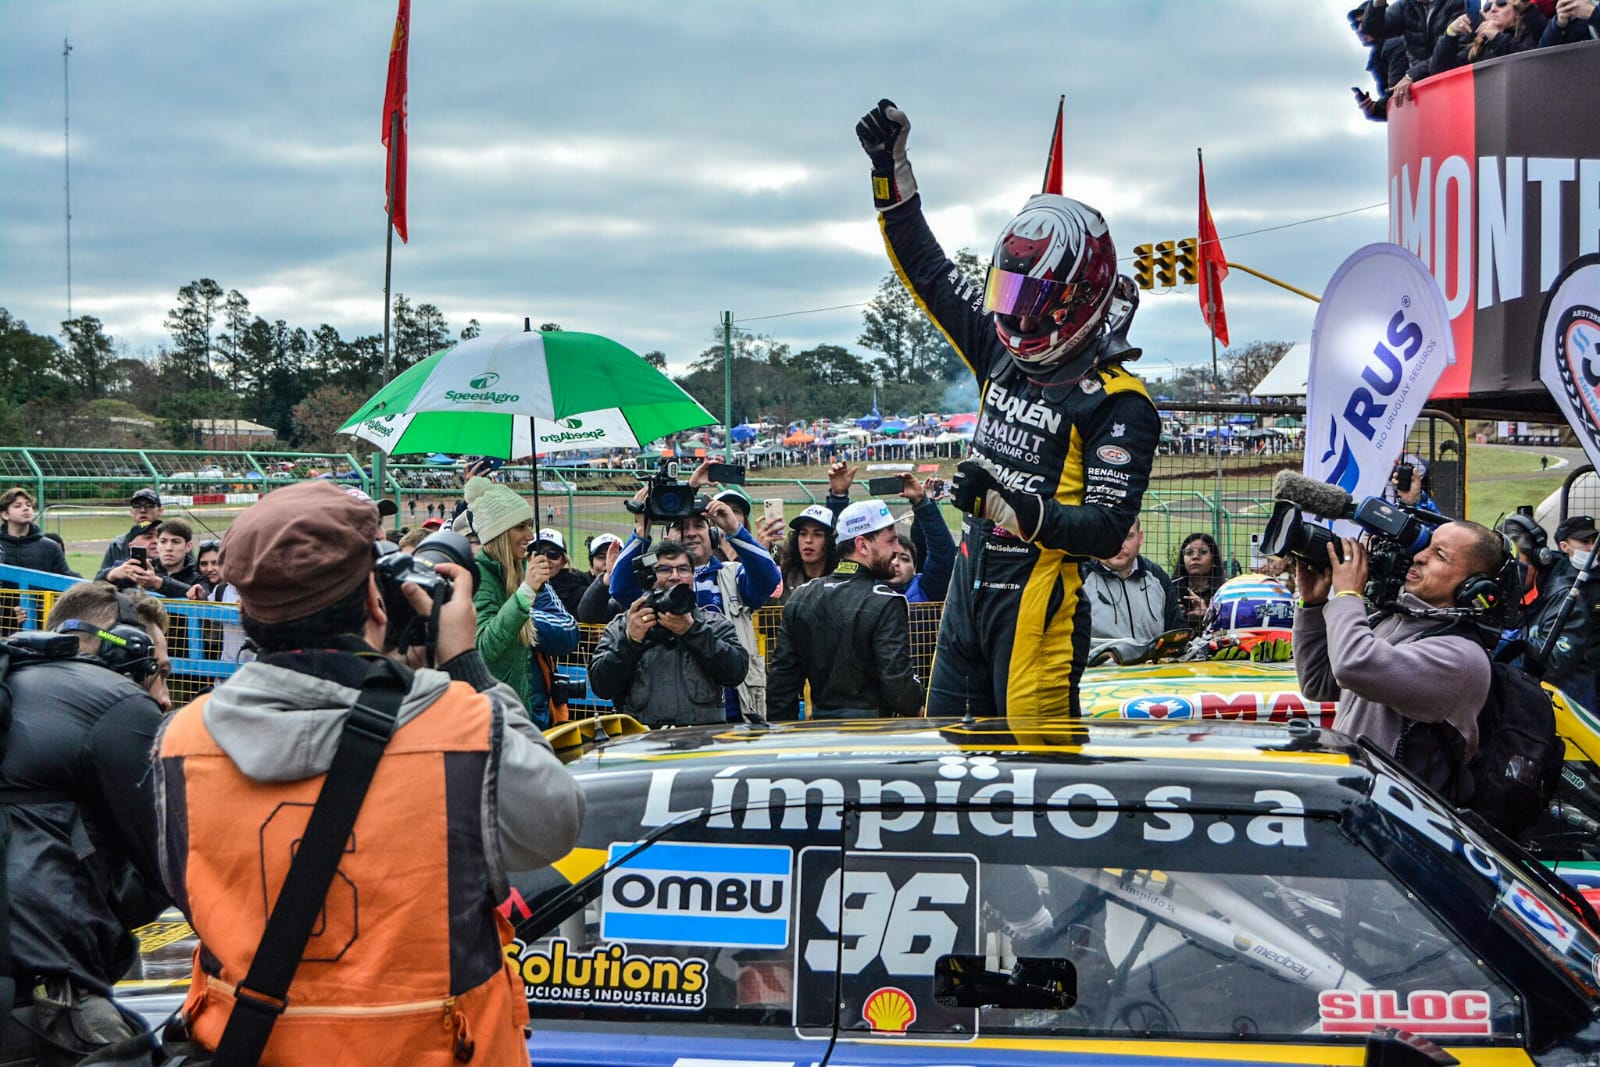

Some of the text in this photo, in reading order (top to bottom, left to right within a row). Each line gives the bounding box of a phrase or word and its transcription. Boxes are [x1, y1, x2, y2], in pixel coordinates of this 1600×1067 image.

[1343, 310, 1423, 441] RUS
[1376, 338, 1437, 450] RIO URUGUAY SEGUROS
[444, 390, 520, 404] SpeedAgro
[1088, 467, 1131, 481] RENAULT
[612, 873, 784, 913] OMBU
[805, 868, 970, 976] 96
[504, 943, 703, 992] Solutions
[1253, 945, 1314, 980] medbay
[595, 988, 701, 1005] INDUSTRIALES
[1320, 992, 1488, 1021] SILOC
